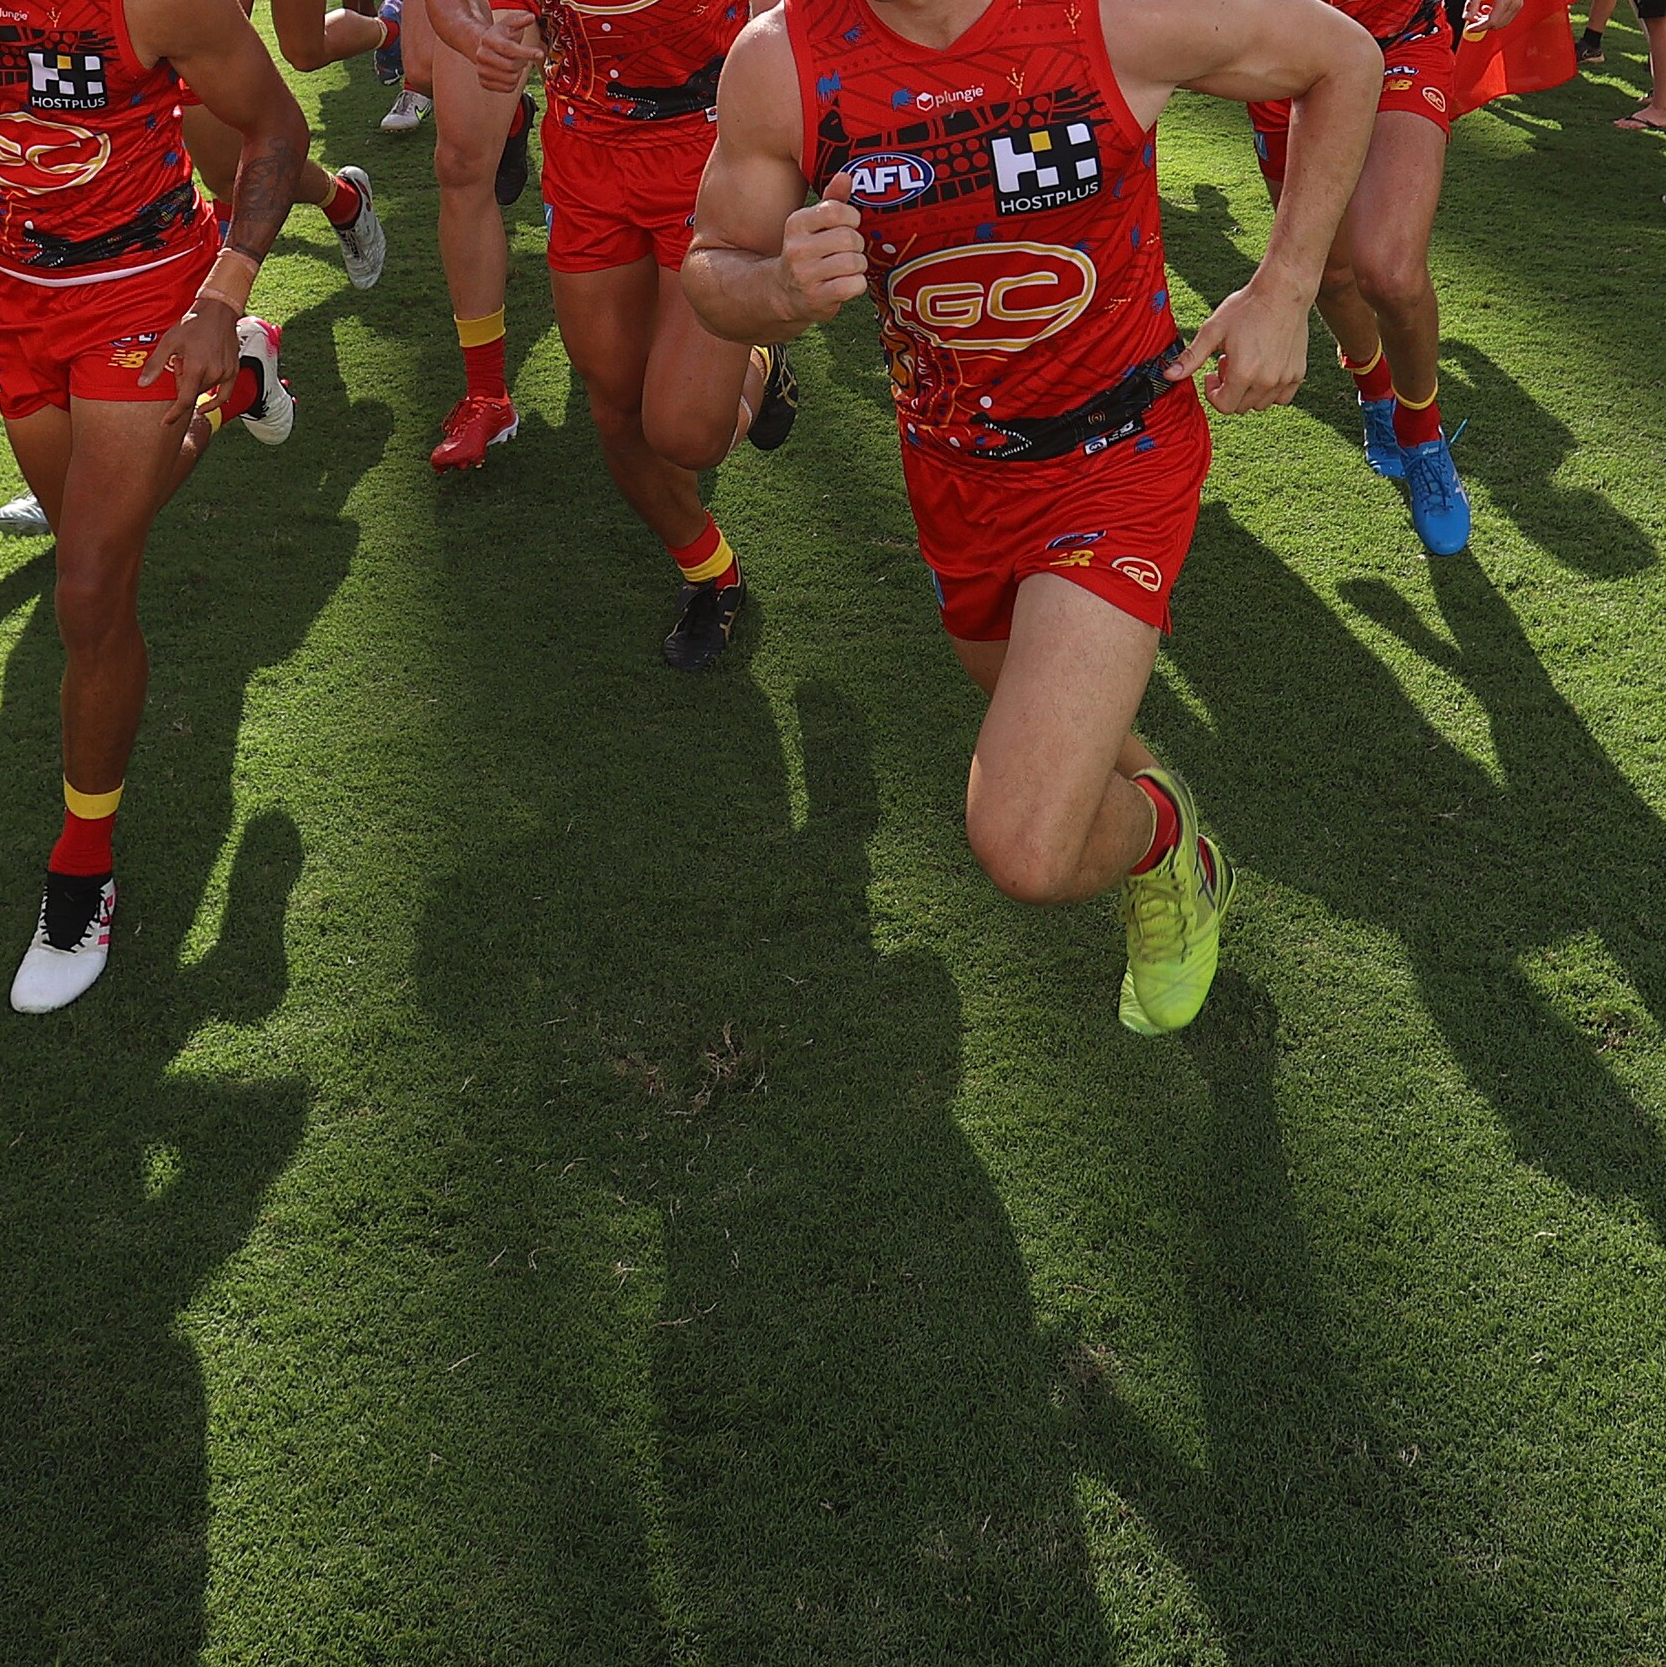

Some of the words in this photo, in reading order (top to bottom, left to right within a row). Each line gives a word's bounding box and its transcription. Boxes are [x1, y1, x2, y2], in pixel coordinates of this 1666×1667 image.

[31, 96, 106, 109] HOSTPLUS
[935, 84, 985, 108] plungie
[852, 163, 927, 194] AFL
[1000, 180, 1101, 214] HOSTPLUS
